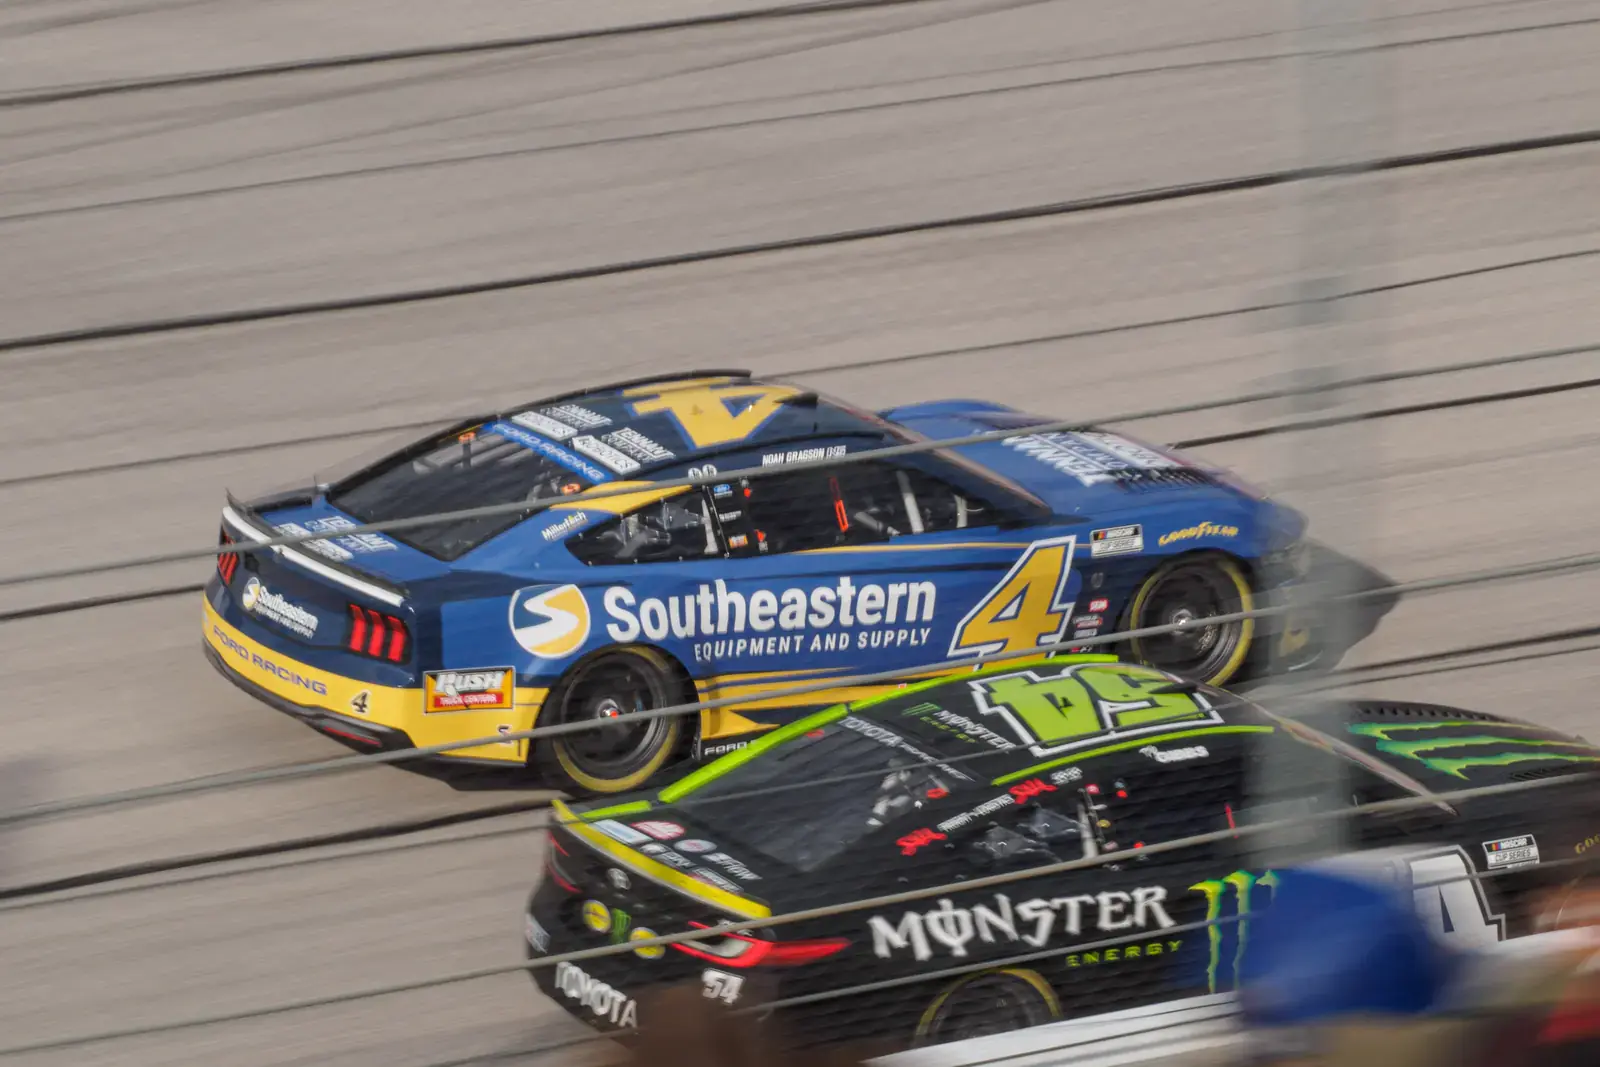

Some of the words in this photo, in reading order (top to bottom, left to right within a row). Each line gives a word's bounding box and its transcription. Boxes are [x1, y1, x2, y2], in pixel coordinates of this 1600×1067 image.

[620, 376, 803, 449] 4
[762, 453, 785, 467] NOAH
[786, 449, 825, 463] GRAGSON
[1158, 521, 1239, 547] GOODYEAR
[603, 576, 937, 643] Southeastern
[947, 535, 1077, 672] 4
[213, 625, 250, 661] FORD
[252, 652, 328, 696] RACING
[694, 634, 804, 662] EQUIPMENT
[810, 630, 850, 651] AND
[857, 627, 932, 649] SUPPLY
[351, 690, 371, 715] 4
[704, 741, 748, 756] FORD
[838, 716, 904, 747] TOYOTA
[867, 884, 1178, 962] MONSTER
[1064, 940, 1184, 968] ENERGY
[555, 960, 639, 1030] TOYOTA
[702, 966, 748, 1006] 54
